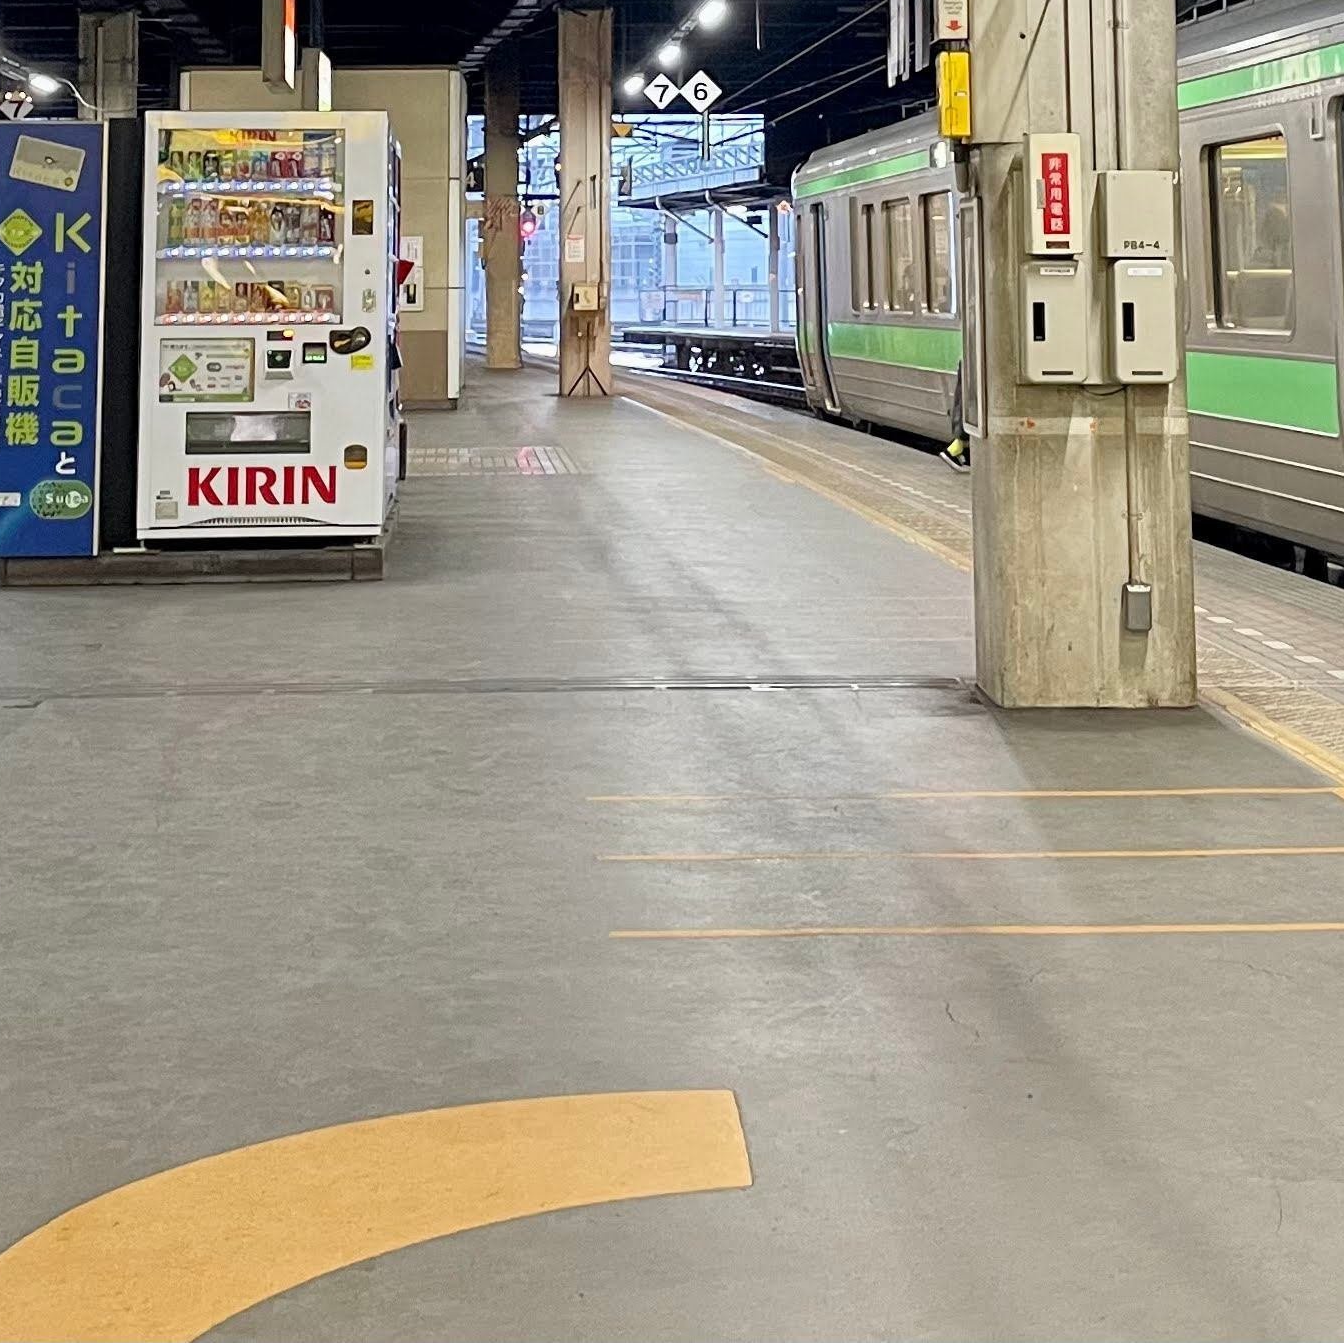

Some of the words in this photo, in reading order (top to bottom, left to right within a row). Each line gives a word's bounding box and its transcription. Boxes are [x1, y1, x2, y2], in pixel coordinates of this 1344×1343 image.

[653, 84, 670, 103] 7
[693, 82, 708, 101] 6
[10, 100, 23, 117] 7
[5, 261, 44, 446] 対応自販機
[187, 465, 337, 506] KIRIN
